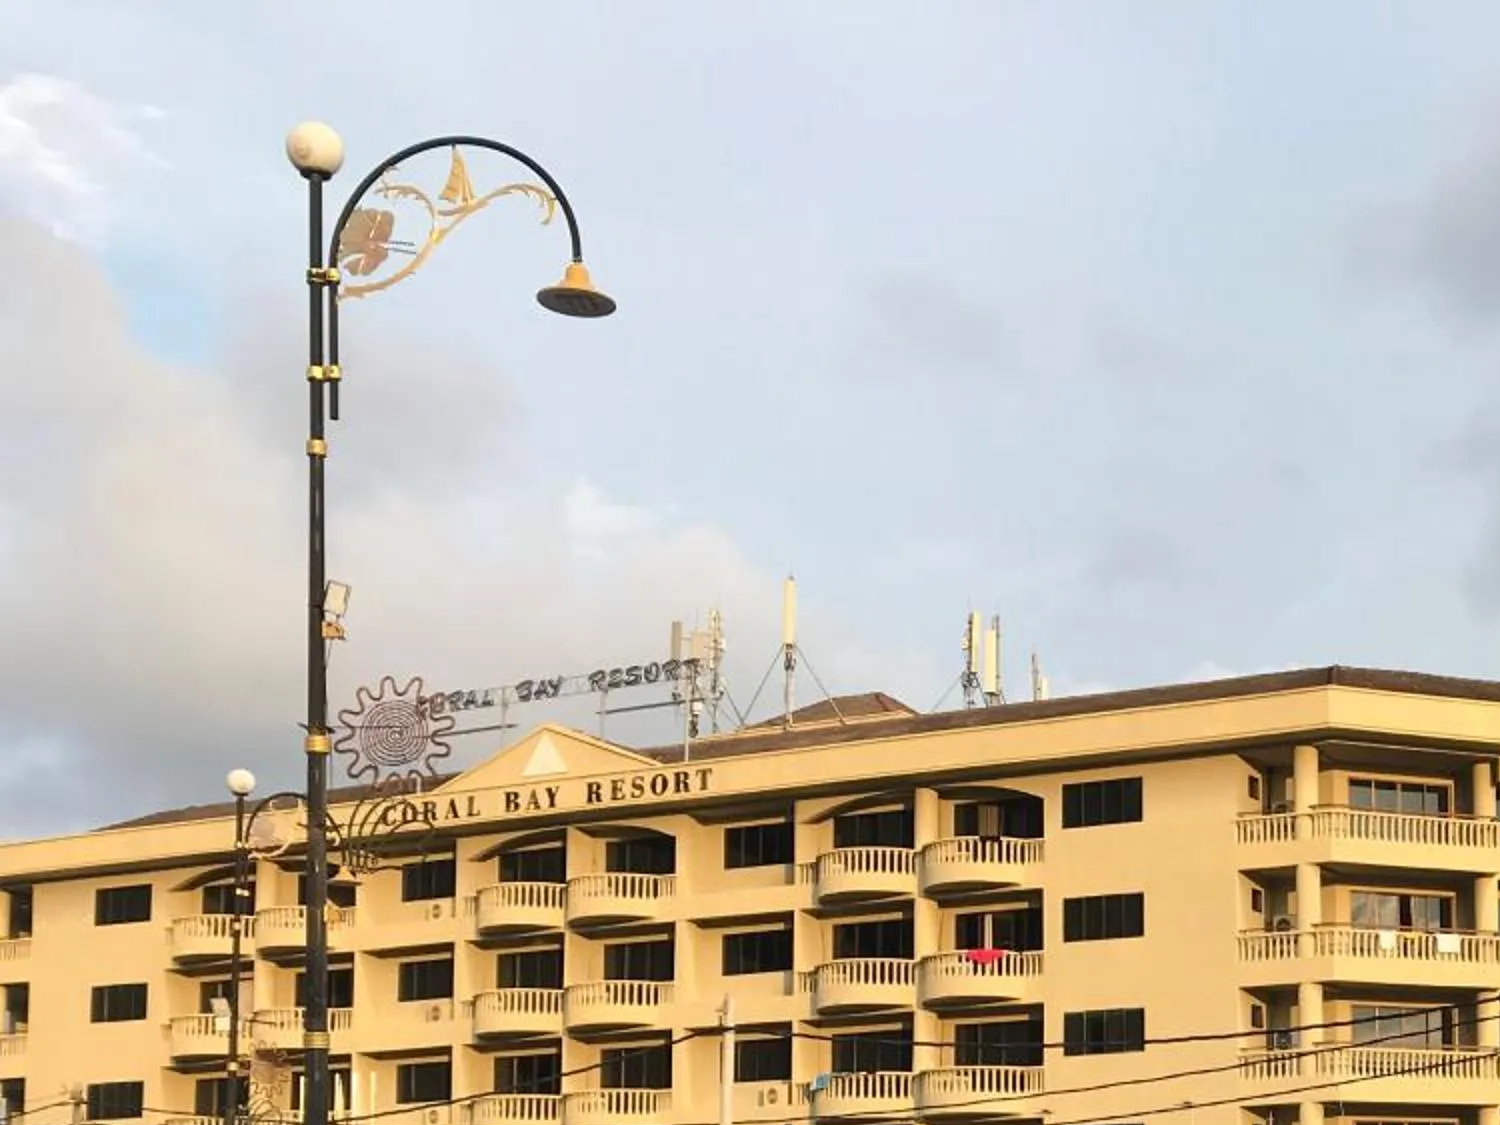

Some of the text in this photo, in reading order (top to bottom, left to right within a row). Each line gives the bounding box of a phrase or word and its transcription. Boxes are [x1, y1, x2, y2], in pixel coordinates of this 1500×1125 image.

[515, 674, 564, 703] BAY
[588, 658, 701, 694] RESORT
[381, 768, 713, 826] CORAL BAY RESORT
